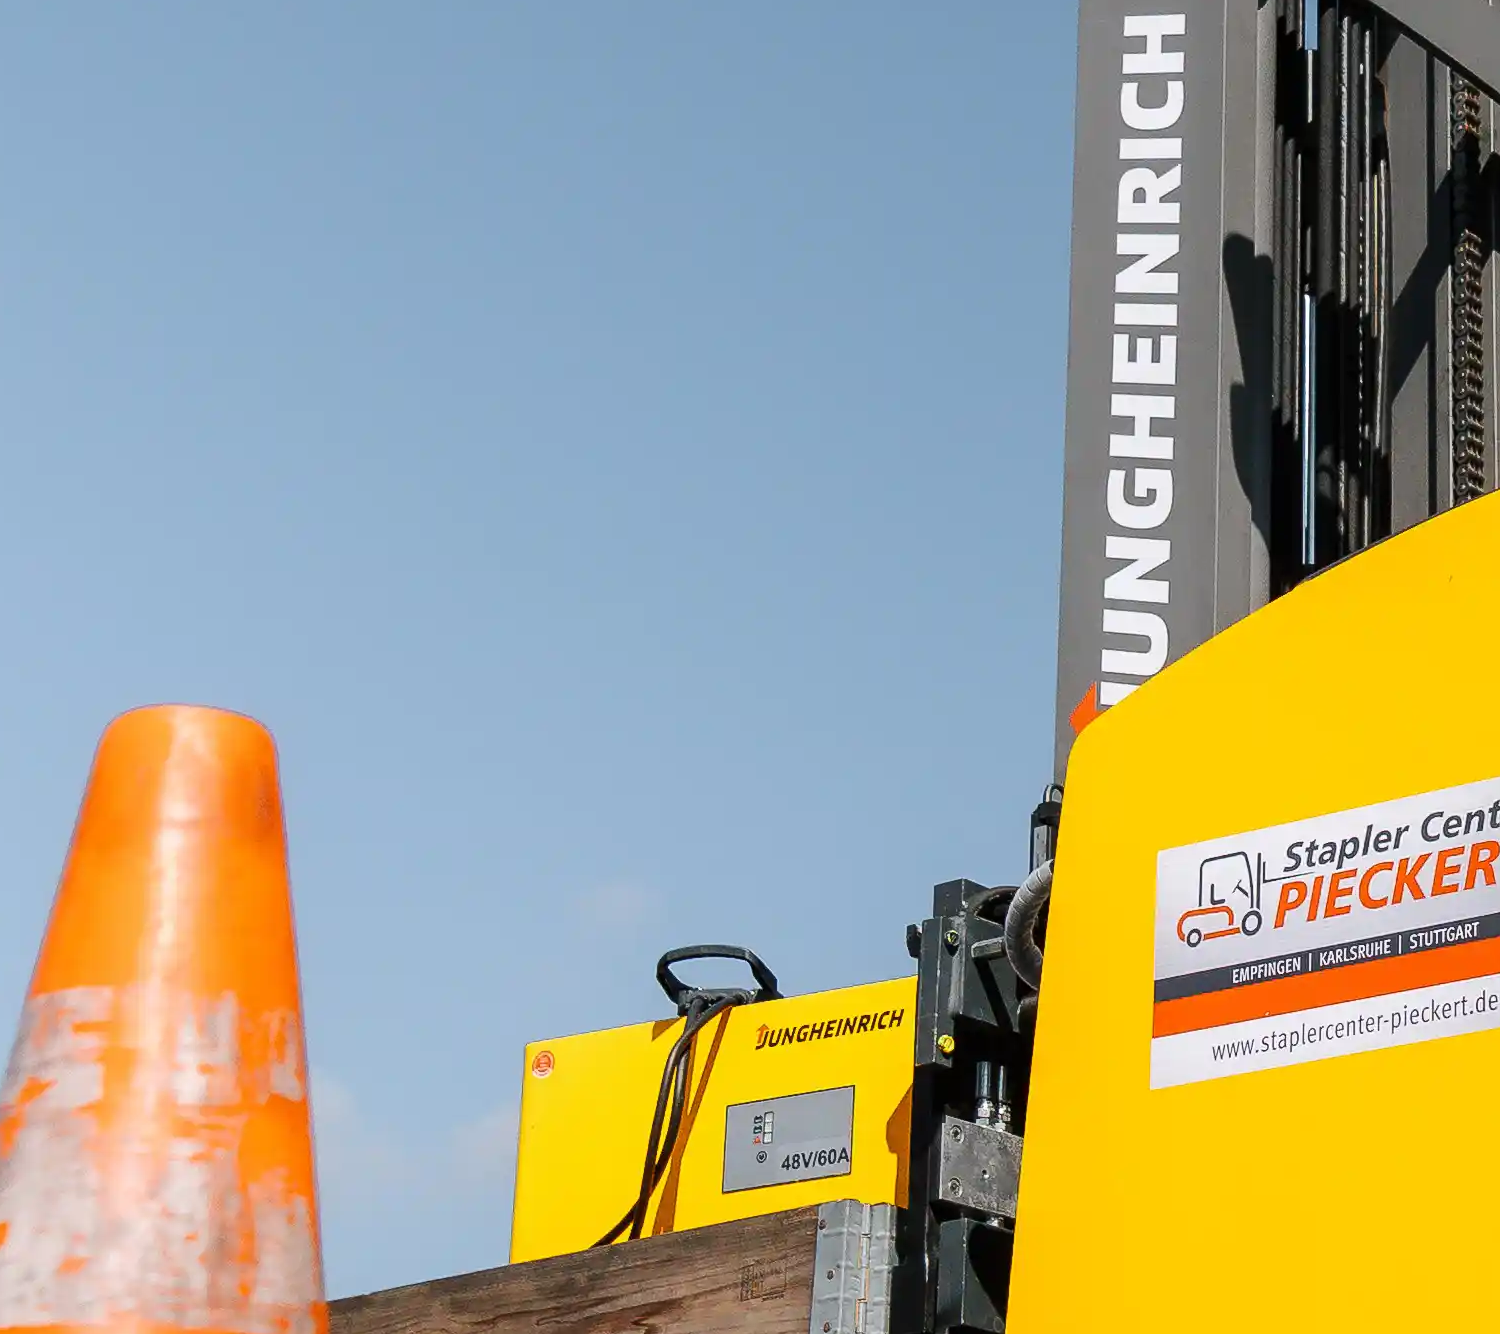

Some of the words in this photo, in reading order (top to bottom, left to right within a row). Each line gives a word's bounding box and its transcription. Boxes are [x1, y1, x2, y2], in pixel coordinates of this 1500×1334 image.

[1283, 823, 1409, 872] Stapler
[1232, 956, 1302, 984] EMPFINGEN
[1319, 938, 1392, 967] KARLSRUHE
[1409, 921, 1480, 950] STUTTGART
[755, 1008, 905, 1050] JUNGHEINRICH
[1212, 990, 1499, 1061] www.staplercenter-pieckert.de
[781, 1147, 850, 1171] 48V/60A
